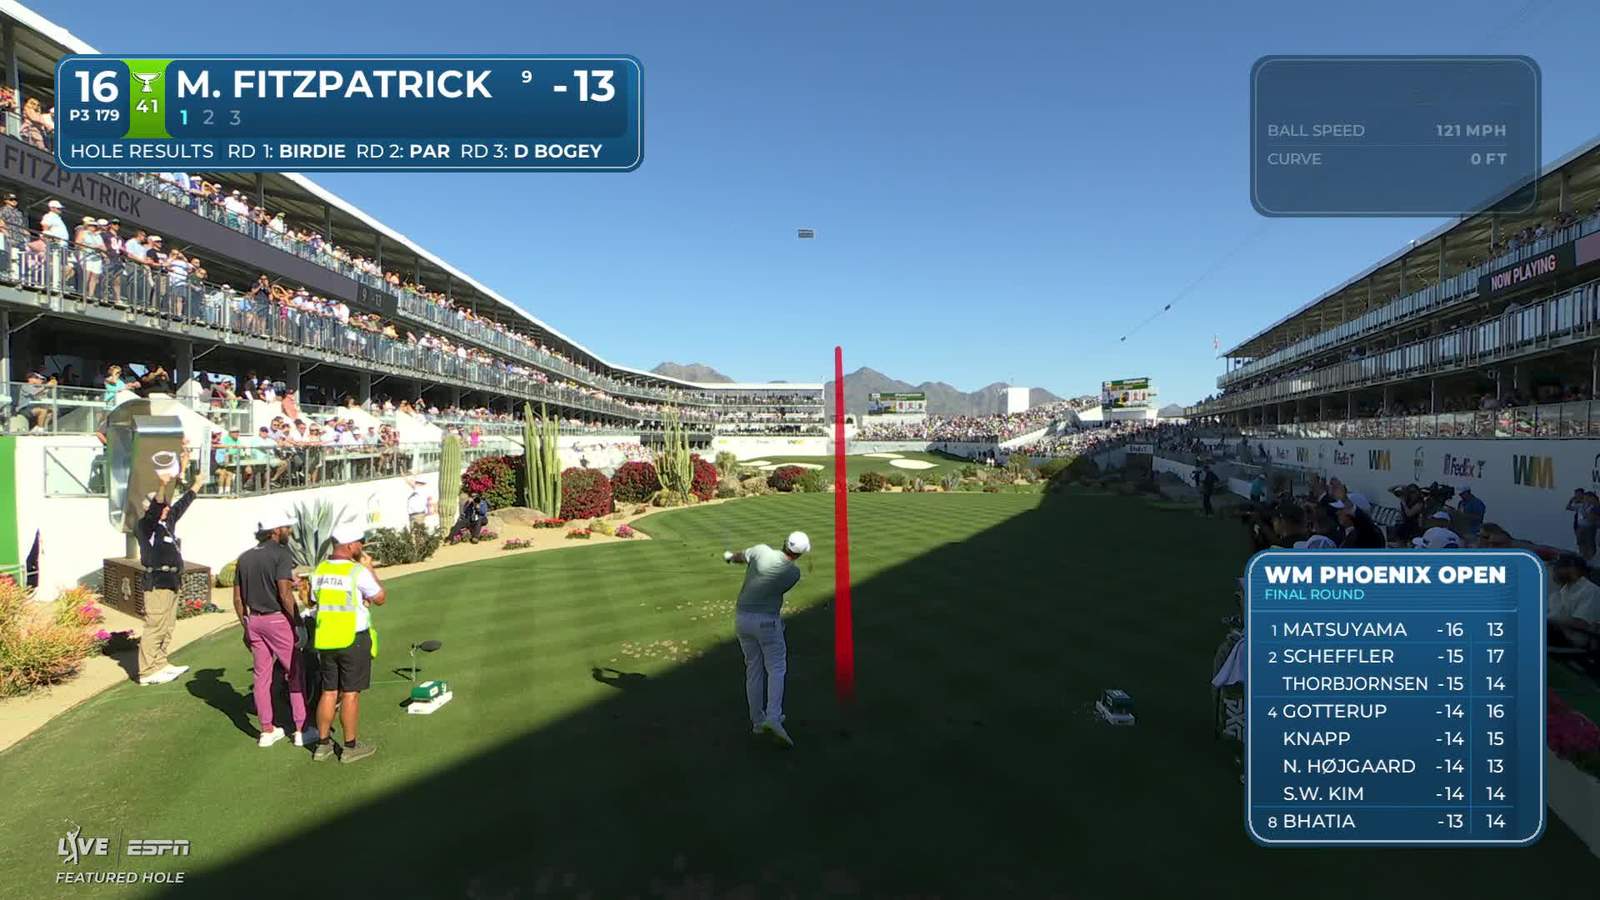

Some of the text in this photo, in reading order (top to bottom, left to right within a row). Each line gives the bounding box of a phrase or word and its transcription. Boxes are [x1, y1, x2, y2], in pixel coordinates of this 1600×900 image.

[4, 144, 141, 218] FITZPATRICK
[1490, 254, 1557, 292] NOW PLAYING
[1369, 449, 1391, 470] WM
[1513, 454, 1554, 489] WM
